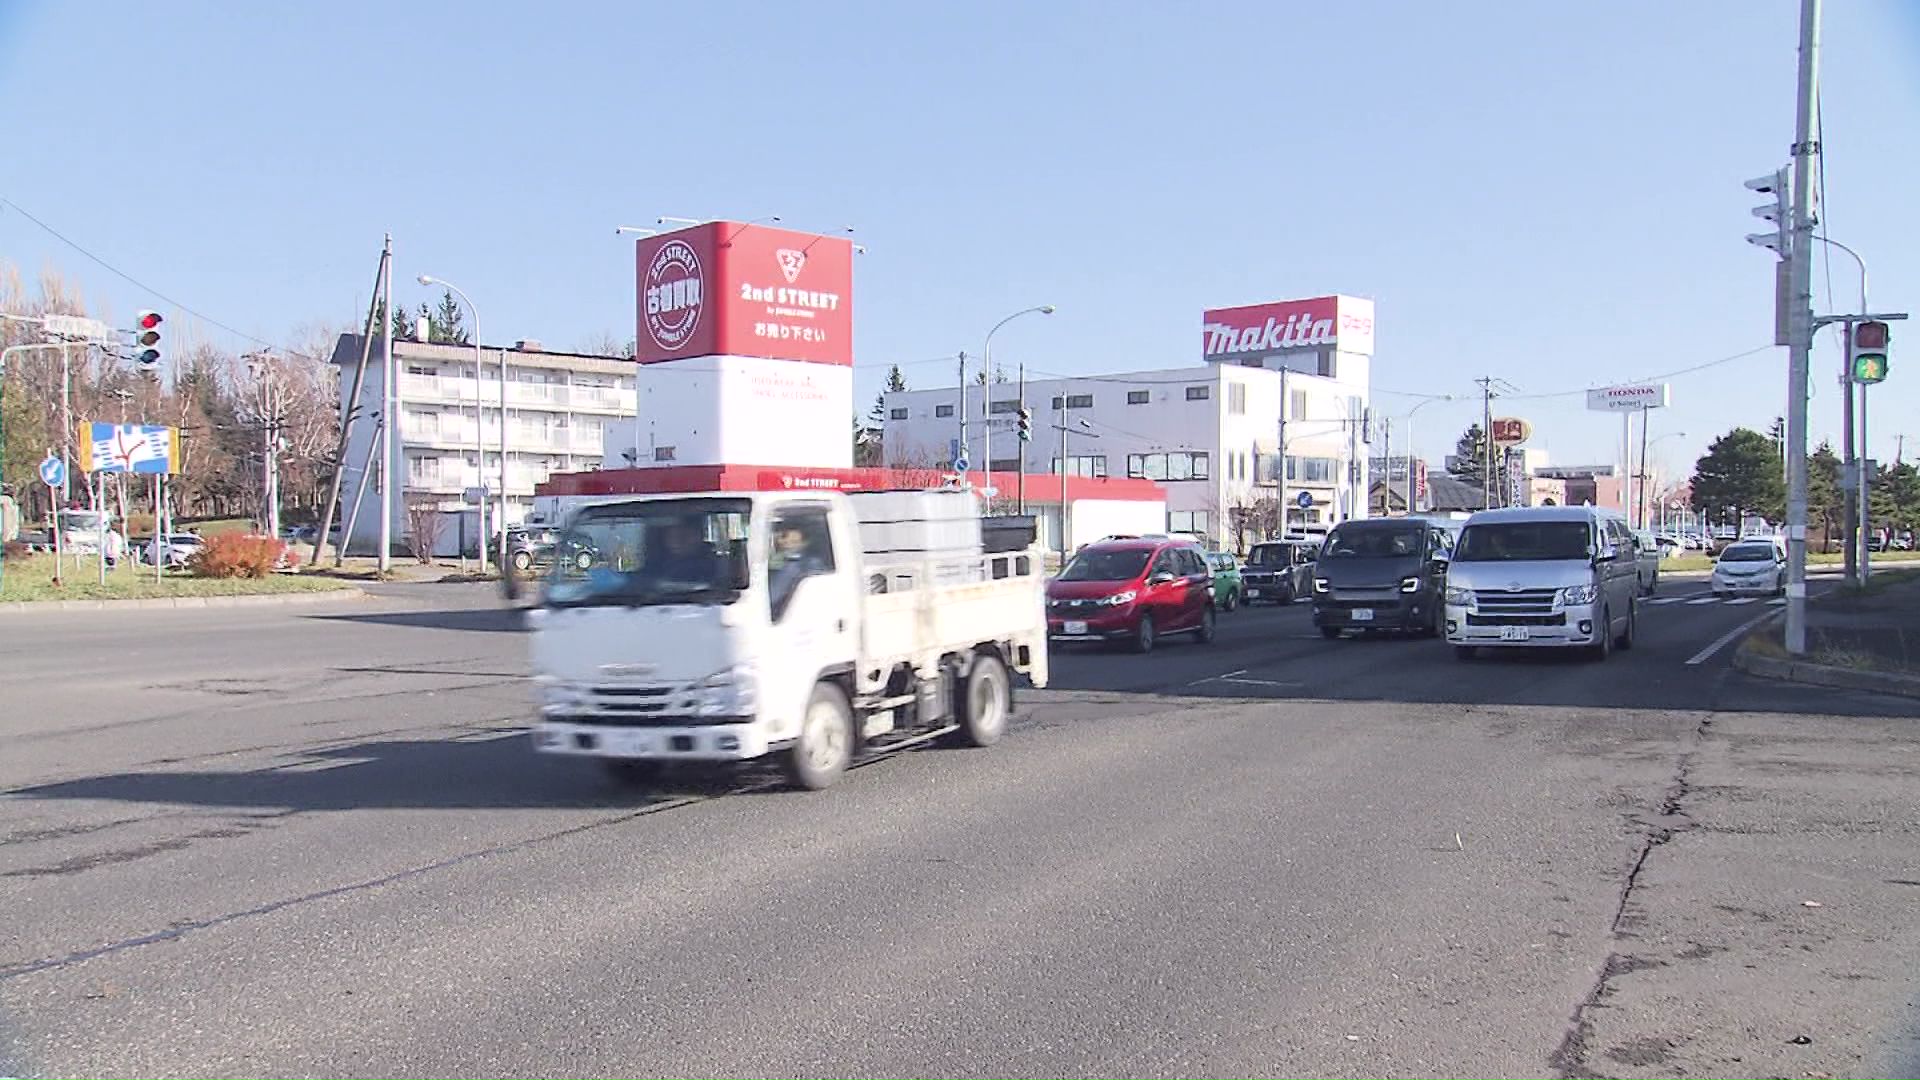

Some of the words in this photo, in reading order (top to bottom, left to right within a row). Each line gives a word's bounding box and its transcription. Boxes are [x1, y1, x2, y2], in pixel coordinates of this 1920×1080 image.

[666, 246, 697, 273] STREET
[741, 283, 774, 302] 2nd
[777, 288, 839, 310] STREET
[1204, 313, 1337, 354] makita
[1608, 388, 1654, 397] HONDA
